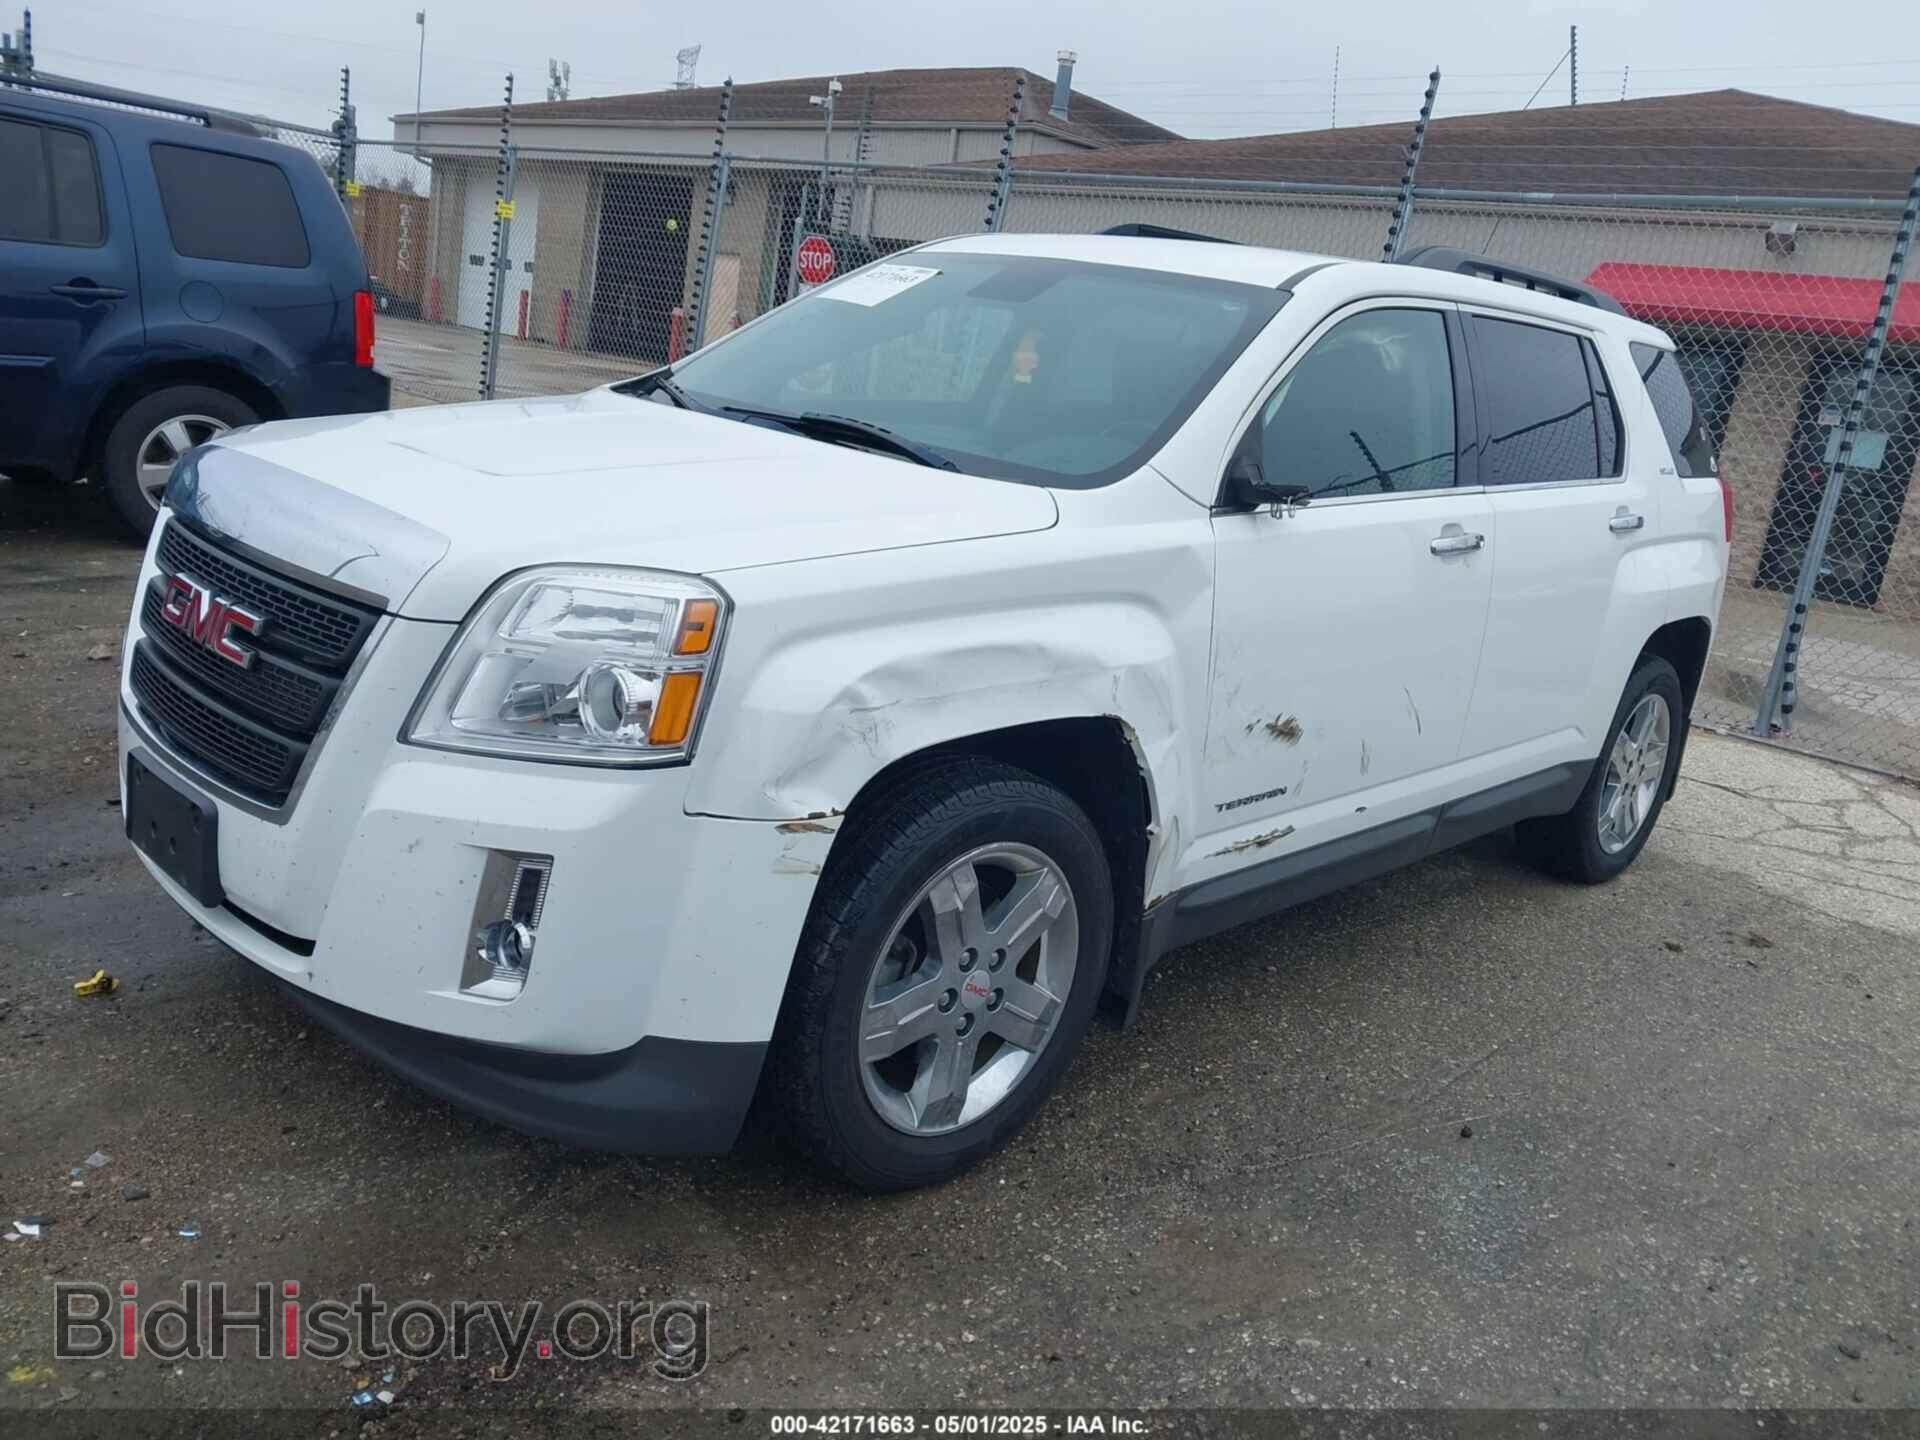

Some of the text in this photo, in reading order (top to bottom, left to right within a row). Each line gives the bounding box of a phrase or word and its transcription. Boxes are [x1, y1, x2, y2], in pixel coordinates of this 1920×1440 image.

[800, 251, 832, 270] STOP
[161, 573, 263, 670] GMC
[1214, 786, 1287, 812] TERRAIN
[965, 983, 989, 998] GMC
